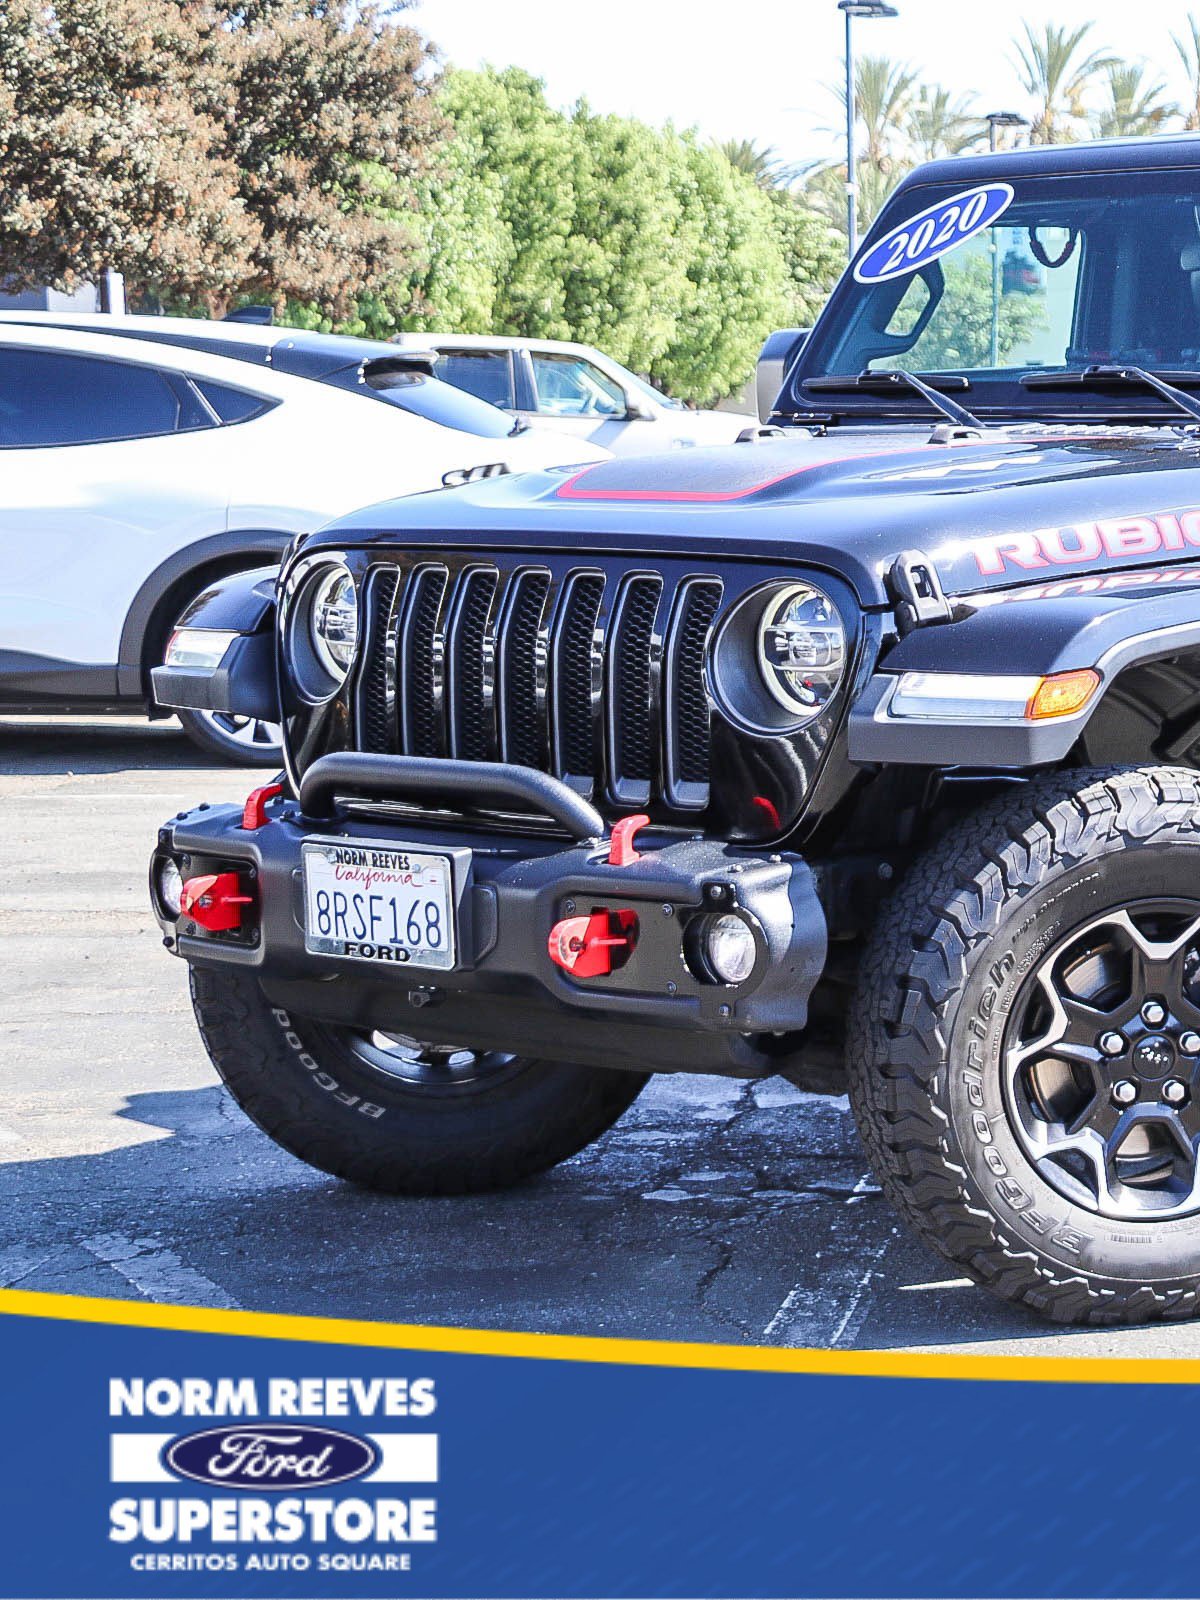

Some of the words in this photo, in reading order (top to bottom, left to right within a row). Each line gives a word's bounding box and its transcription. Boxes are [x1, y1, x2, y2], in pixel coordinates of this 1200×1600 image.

[879, 191, 988, 275] 2020
[336, 848, 368, 867] NORM
[372, 852, 410, 870] REEVES
[335, 865, 424, 890] California
[316, 889, 442, 948] 8RSF168
[344, 941, 412, 962] FORD
